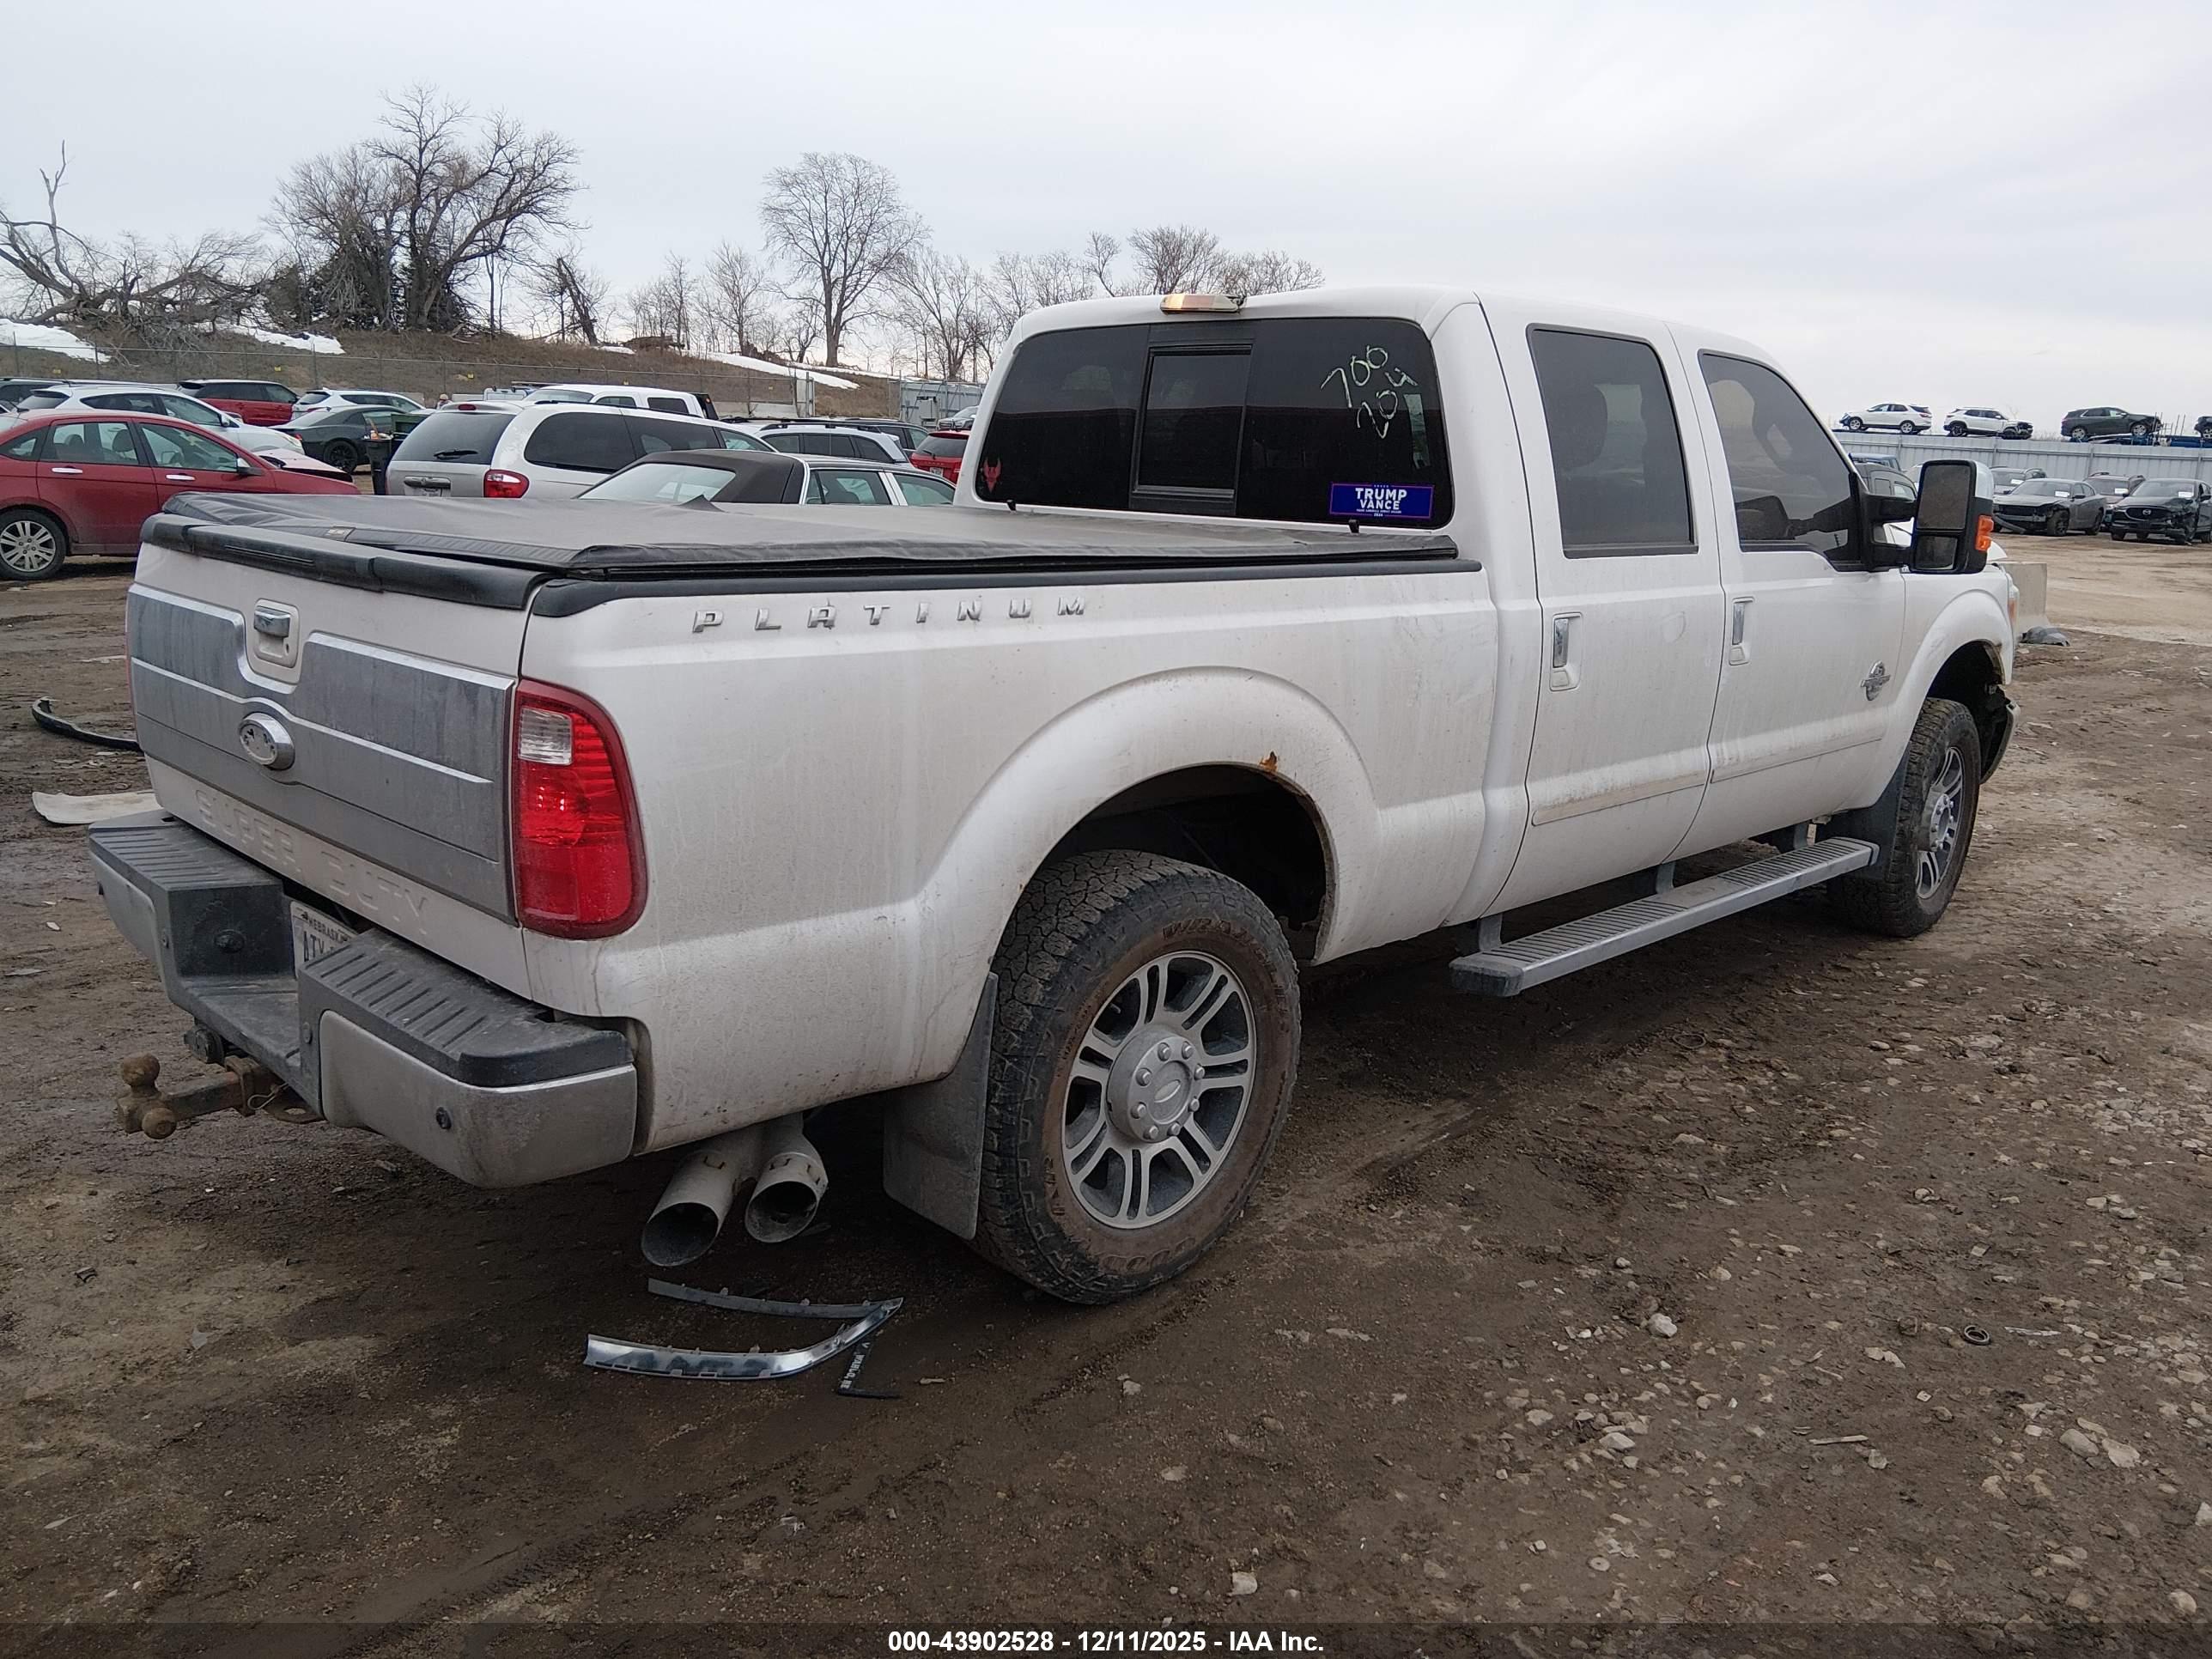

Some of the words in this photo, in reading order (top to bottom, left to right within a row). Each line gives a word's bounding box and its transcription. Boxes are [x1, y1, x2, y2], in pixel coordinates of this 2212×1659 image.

[1355, 488, 1407, 501] TRUMP
[1360, 500, 1401, 510] VANCE
[692, 595, 1087, 634] PLATINUM
